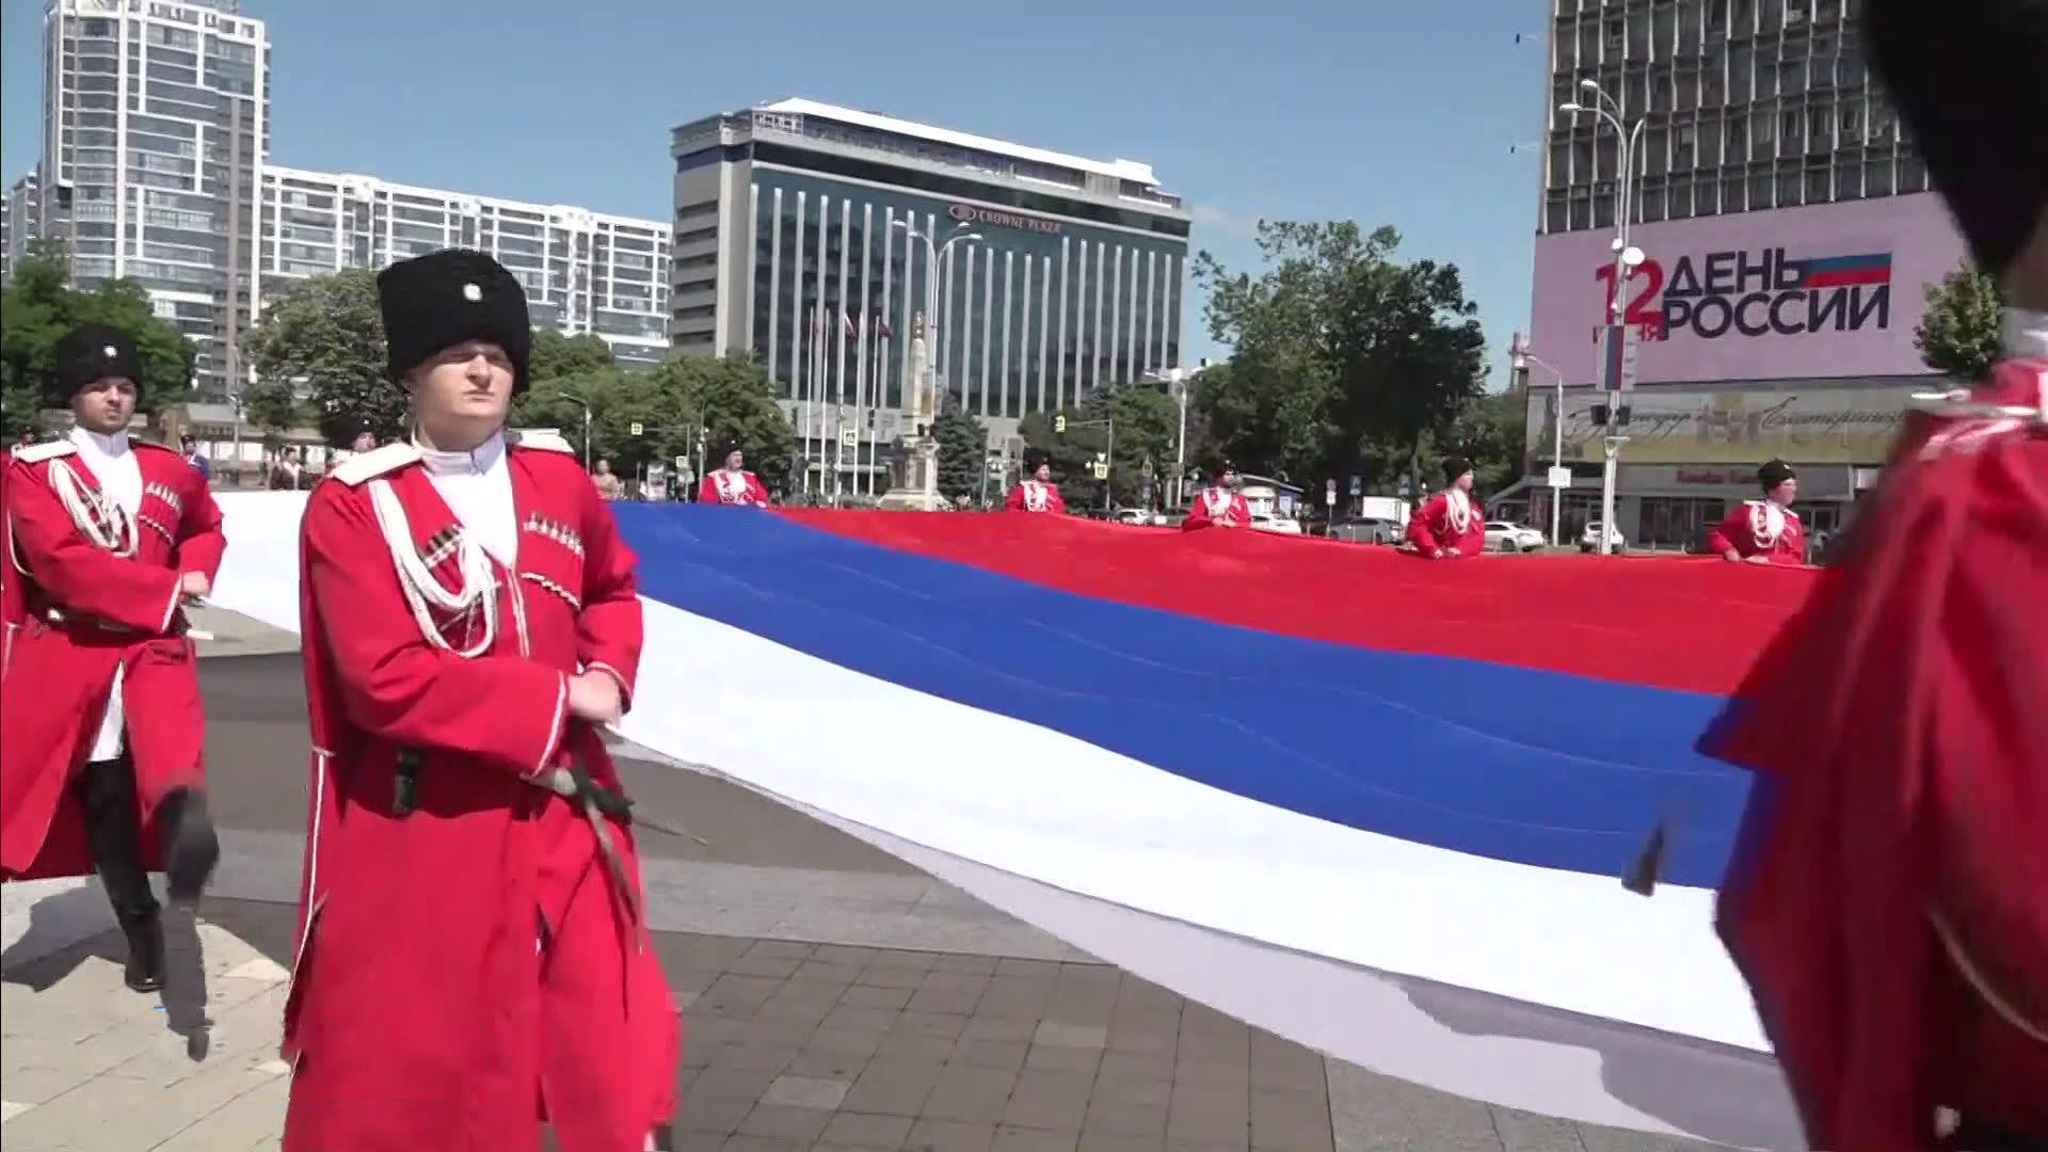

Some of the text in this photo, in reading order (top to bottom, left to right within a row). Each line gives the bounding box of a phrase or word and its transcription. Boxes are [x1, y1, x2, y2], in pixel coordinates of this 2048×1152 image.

[979, 210, 1061, 235] CROWNE PLAZA
[1595, 259, 1664, 324] 12
[1663, 248, 1809, 297] ДЕНЬ
[1663, 285, 1890, 341] РОССИИ
